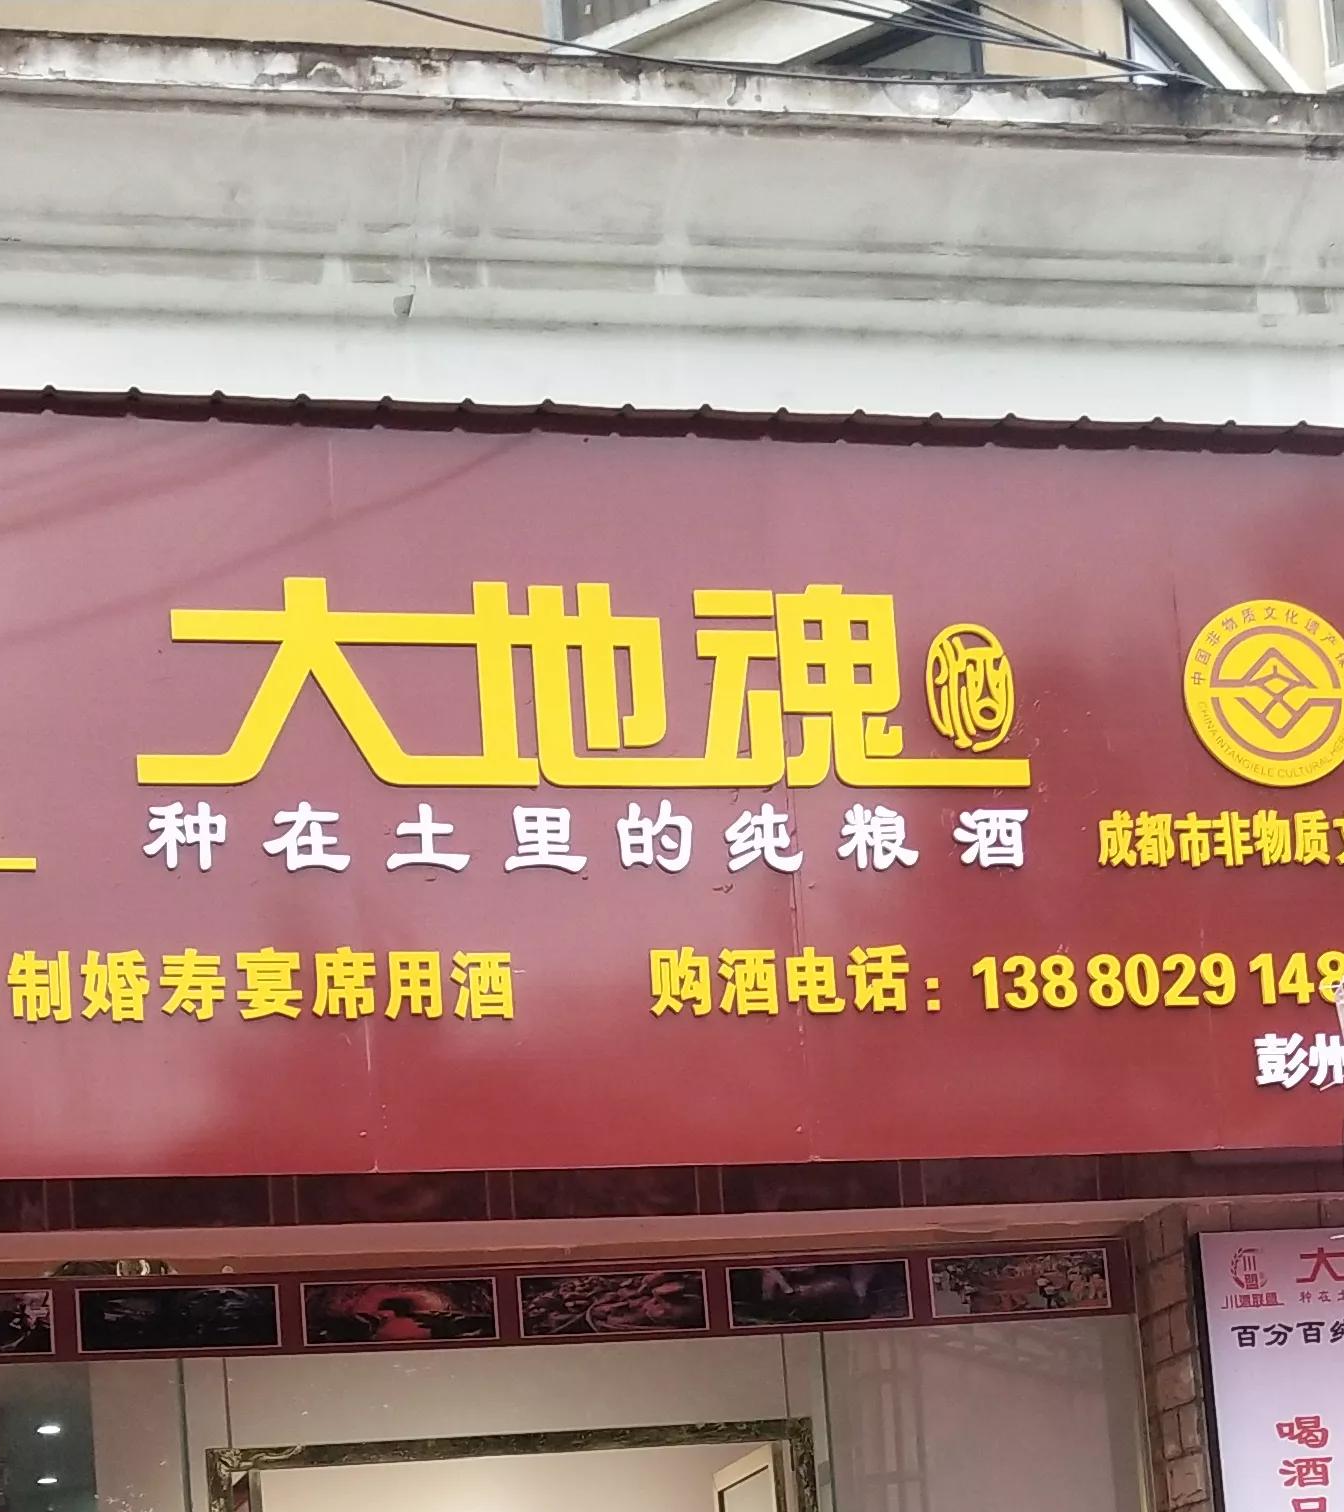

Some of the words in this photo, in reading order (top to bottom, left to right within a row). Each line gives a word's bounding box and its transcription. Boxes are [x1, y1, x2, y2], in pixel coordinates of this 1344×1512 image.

[143, 800, 1030, 875] 种在土里的纯粮酒
